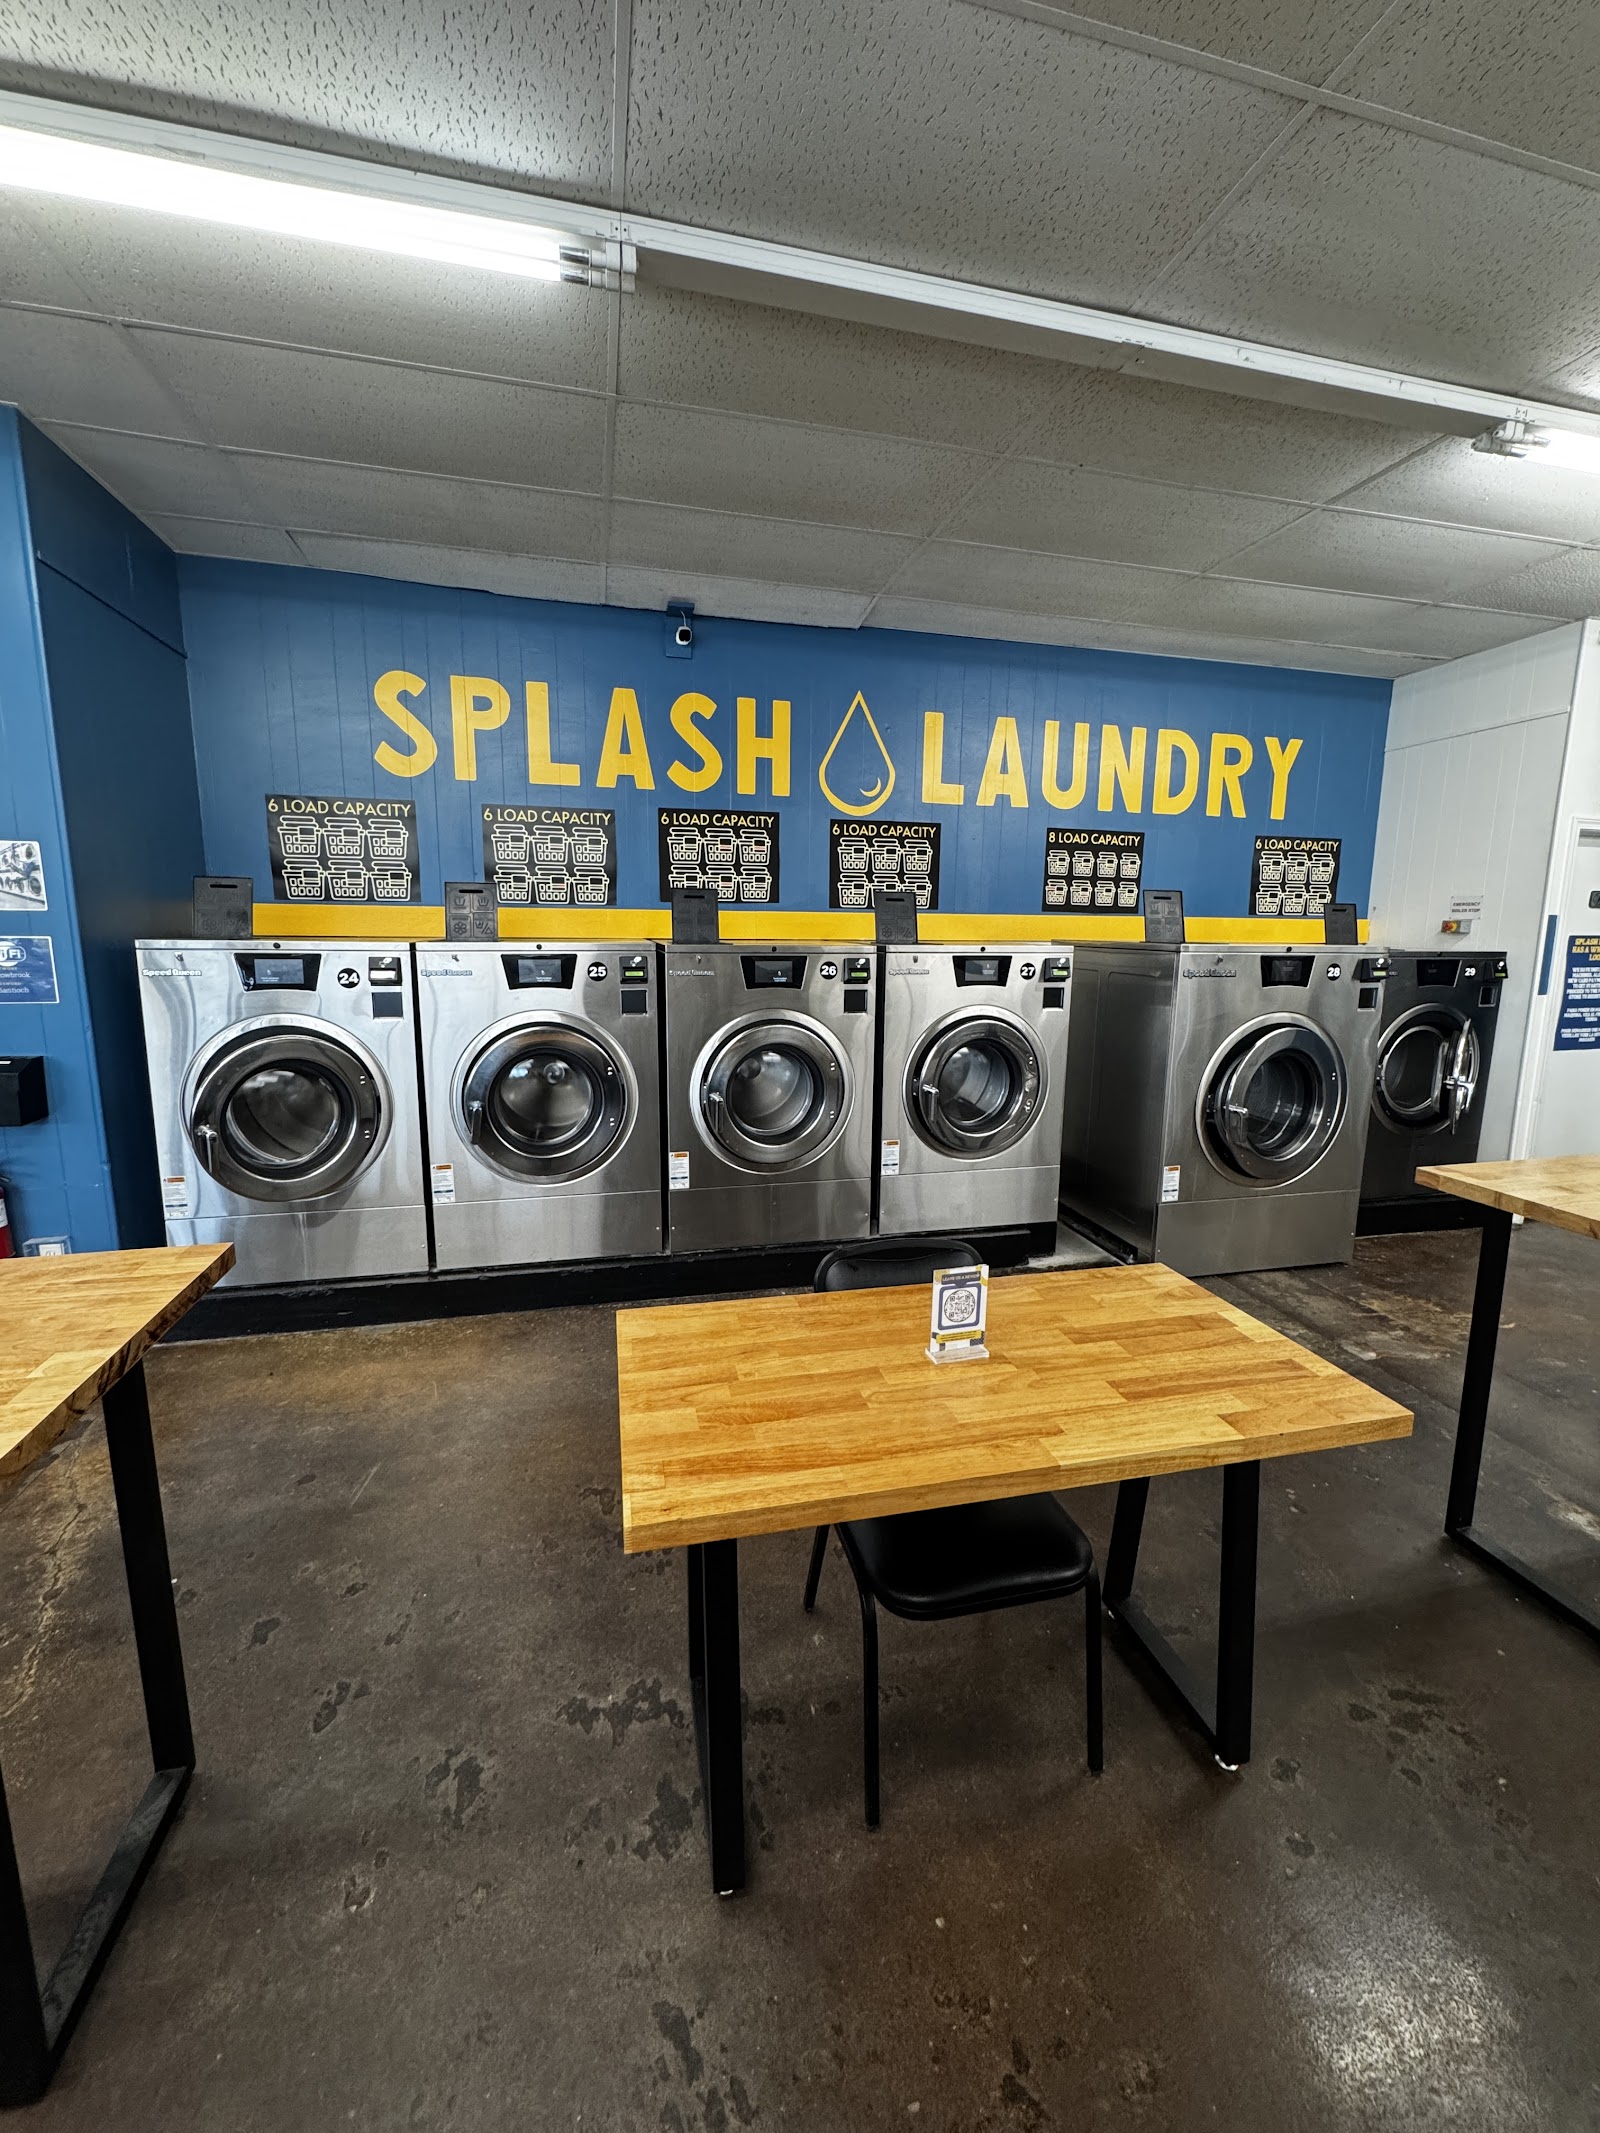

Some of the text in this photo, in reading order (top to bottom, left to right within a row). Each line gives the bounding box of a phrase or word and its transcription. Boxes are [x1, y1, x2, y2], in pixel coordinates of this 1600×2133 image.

[373, 669, 1304, 822] SPLASH LAUNDRY
[267, 799, 411, 817] 6 LOAD CAPACITY
[483, 808, 611, 825] 6 LOAD CAPACITY
[660, 812, 775, 828] 6 LOAD CAPACITY
[832, 823, 937, 838] 6 LOAD CAPACITY
[1048, 832, 1141, 847] 8 LOAD CAPACITY
[1255, 838, 1339, 852] 6 LOAD CAPACITY
[142, 968, 202, 978] Speed Queen
[588, 966, 607, 977] 25
[821, 965, 837, 976] 26
[1020, 966, 1035, 977] 27
[1327, 966, 1340, 977] 28
[1464, 967, 1476, 976] 29
[338, 972, 360, 985] 24
